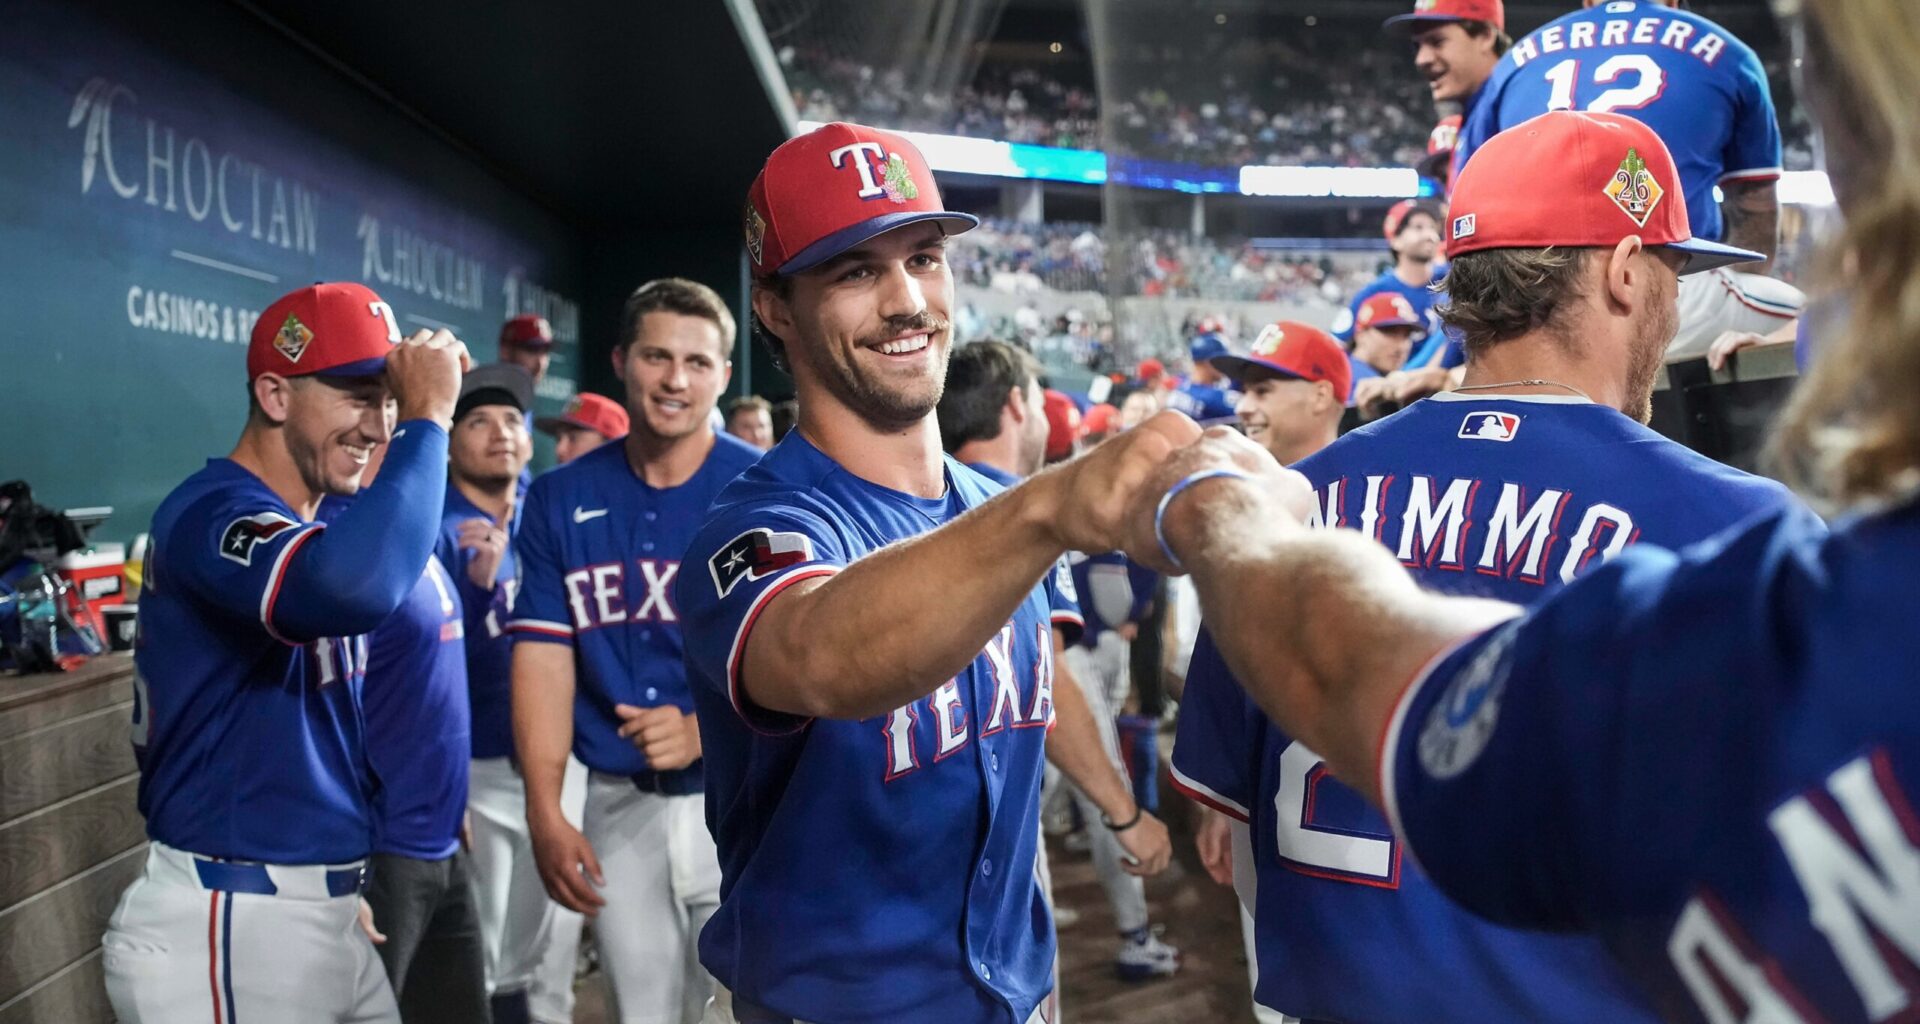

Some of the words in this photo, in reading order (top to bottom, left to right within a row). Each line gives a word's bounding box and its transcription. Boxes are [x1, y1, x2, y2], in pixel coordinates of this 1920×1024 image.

[1511, 17, 1727, 67] HERRERA
[1544, 54, 1667, 112] 12
[102, 84, 319, 255] CHOCTAW
[829, 141, 888, 201] T
[1616, 170, 1651, 202] 26
[127, 284, 219, 341] CASINOS
